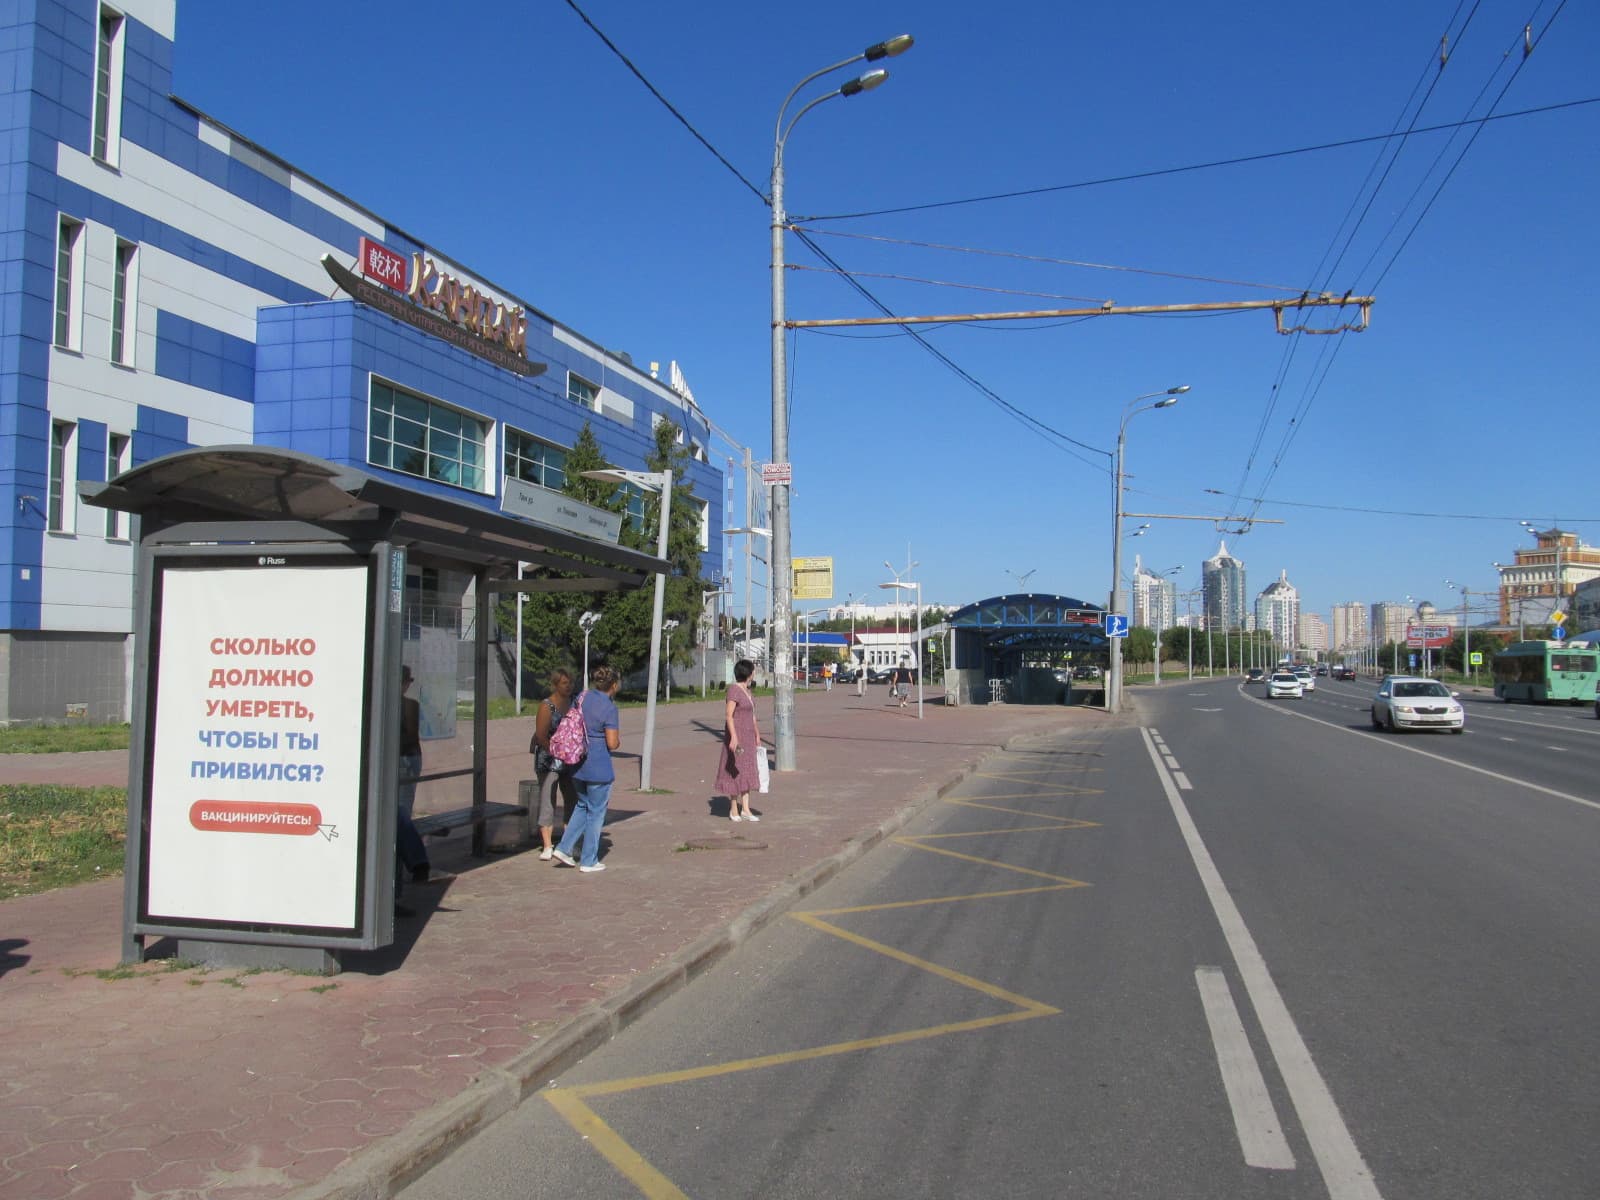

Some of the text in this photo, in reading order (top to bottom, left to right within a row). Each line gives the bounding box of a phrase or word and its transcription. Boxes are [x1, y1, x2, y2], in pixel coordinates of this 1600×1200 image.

[369, 247, 401, 283] 乾杯
[267, 557, 286, 565] Russ
[210, 638, 316, 656] СКОЛЬКО
[208, 668, 314, 689] ДОЛЖНО
[206, 699, 315, 722] УМЕРЕТЬ,
[199, 730, 319, 750] ЧТОБЫ ТЫ
[191, 760, 324, 782] ПРИВИЛСЯ?
[201, 810, 312, 825] ВАКЦИНИРУЙТЕСЬ!
